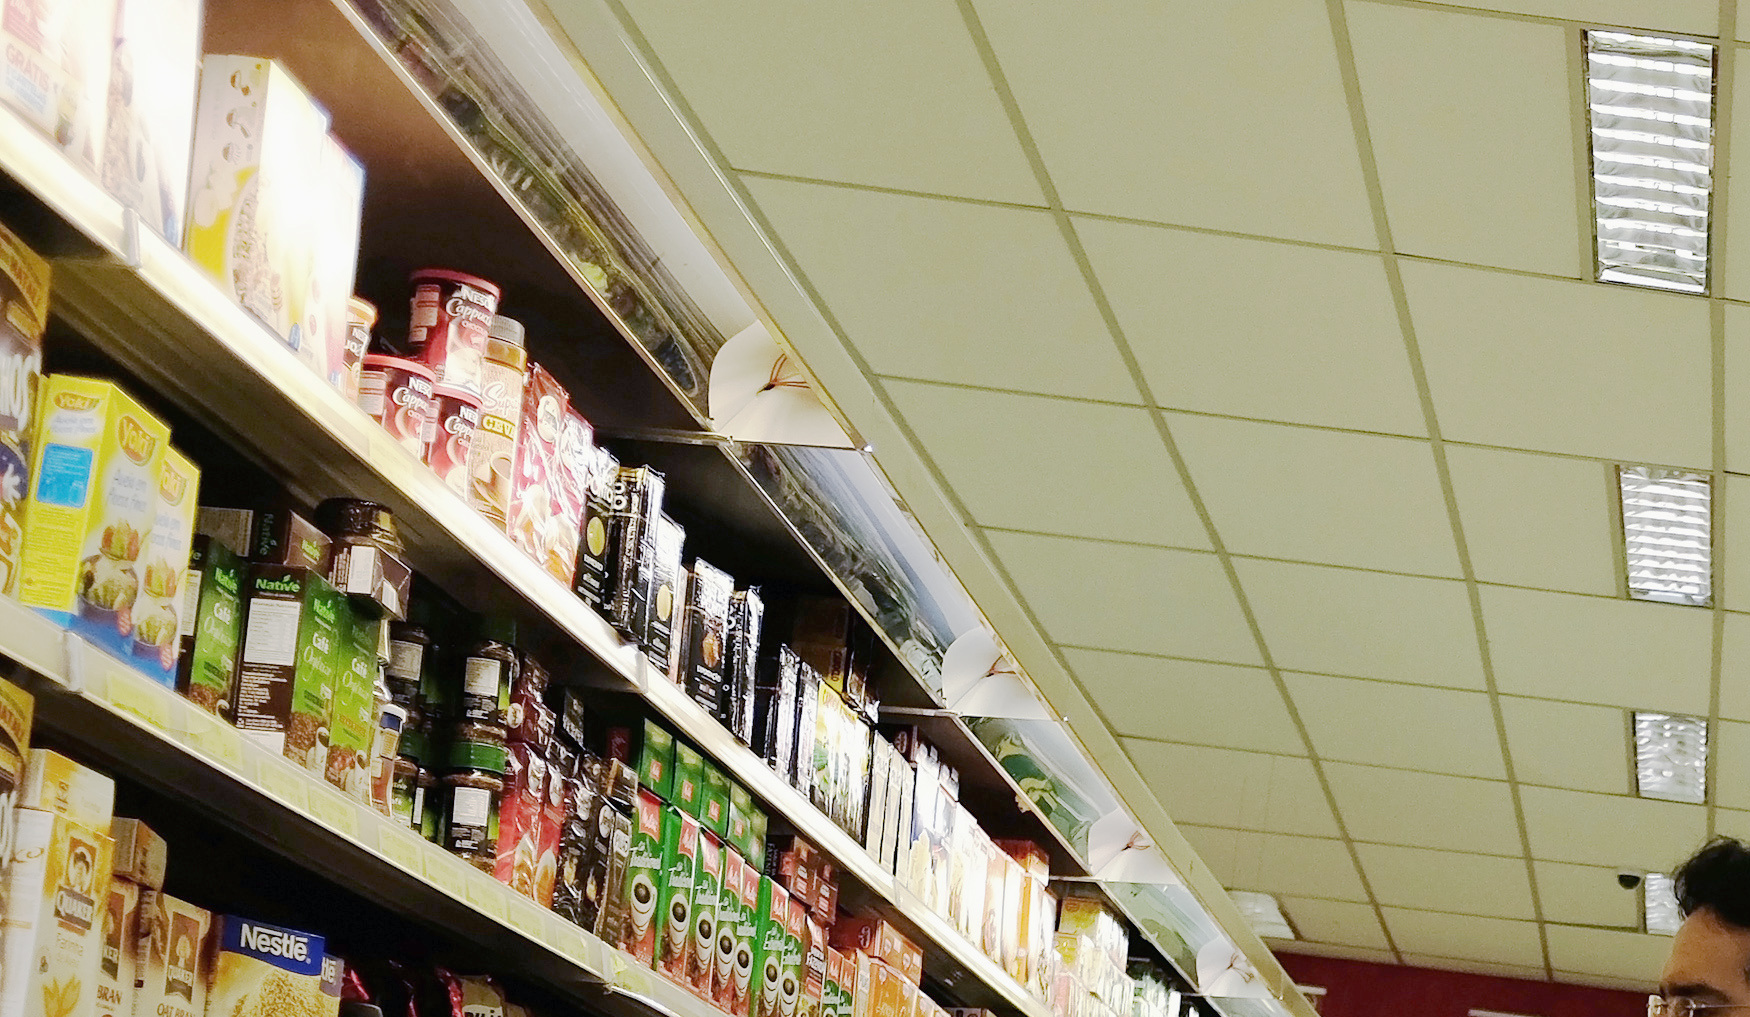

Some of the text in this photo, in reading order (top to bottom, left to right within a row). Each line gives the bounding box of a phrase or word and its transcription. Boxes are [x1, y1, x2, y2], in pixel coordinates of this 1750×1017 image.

[255, 575, 301, 593] Native
[57, 890, 93, 923] QUAKER
[240, 923, 309, 963] Nestlé
[96, 984, 122, 1005] BRAN
